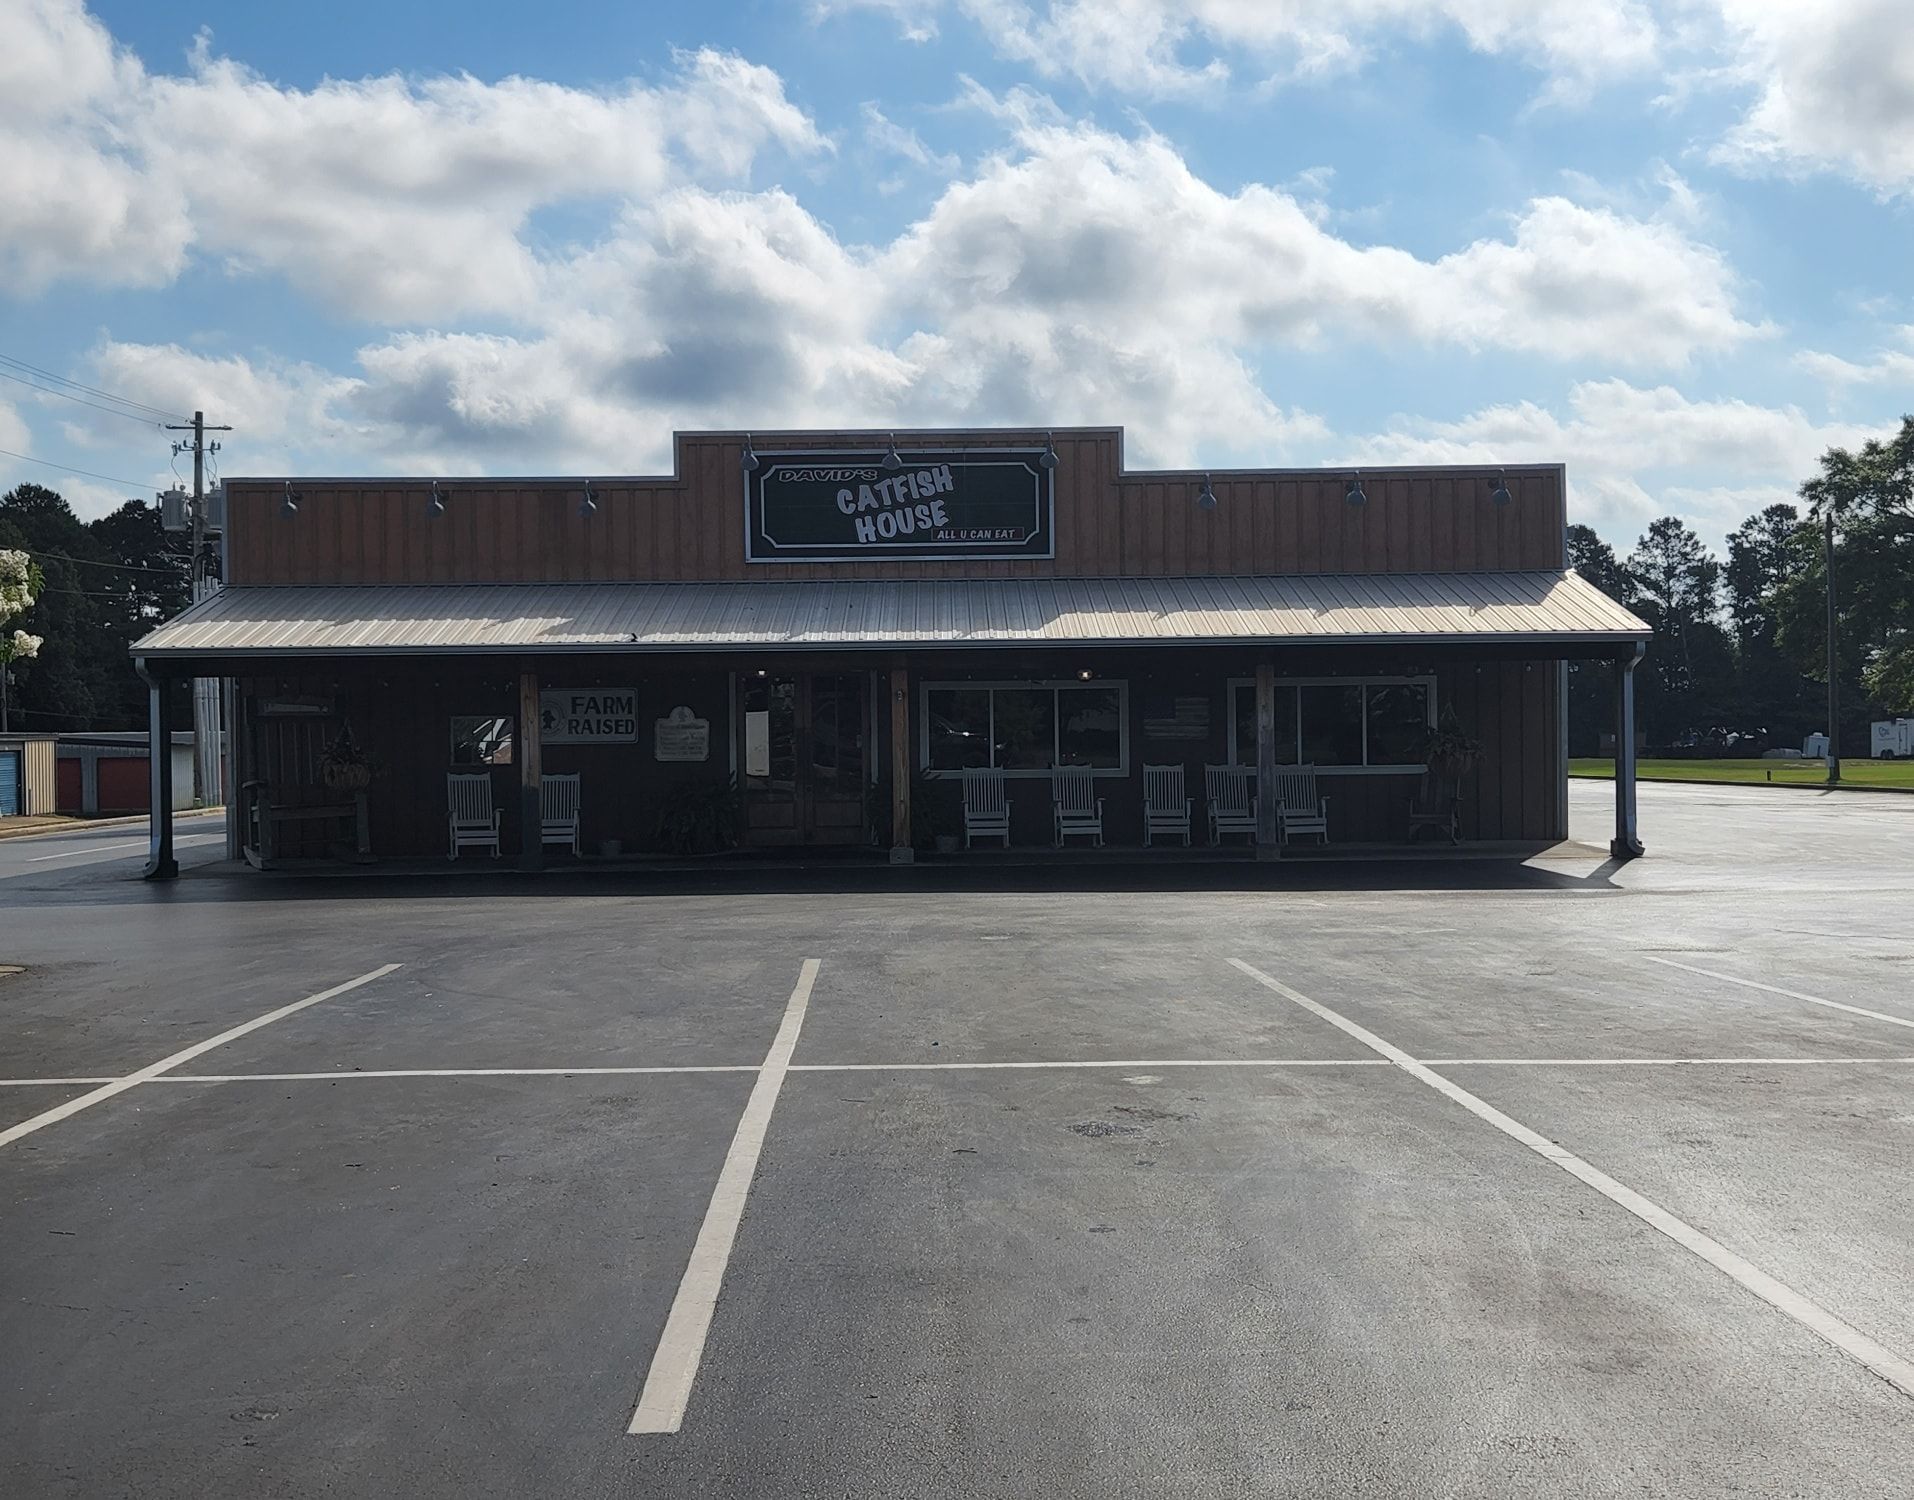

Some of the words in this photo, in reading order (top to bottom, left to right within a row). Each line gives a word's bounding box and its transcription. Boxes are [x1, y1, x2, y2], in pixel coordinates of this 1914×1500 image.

[779, 468, 878, 483] DAVID'S
[837, 464, 953, 514] CATFISH
[855, 500, 949, 543] HOUSE
[937, 529, 956, 539] ALL
[960, 529, 967, 539] U
[970, 529, 992, 539] CAN
[995, 529, 1015, 538] EAT
[571, 696, 633, 715] FARM
[567, 719, 634, 735] RAISED
